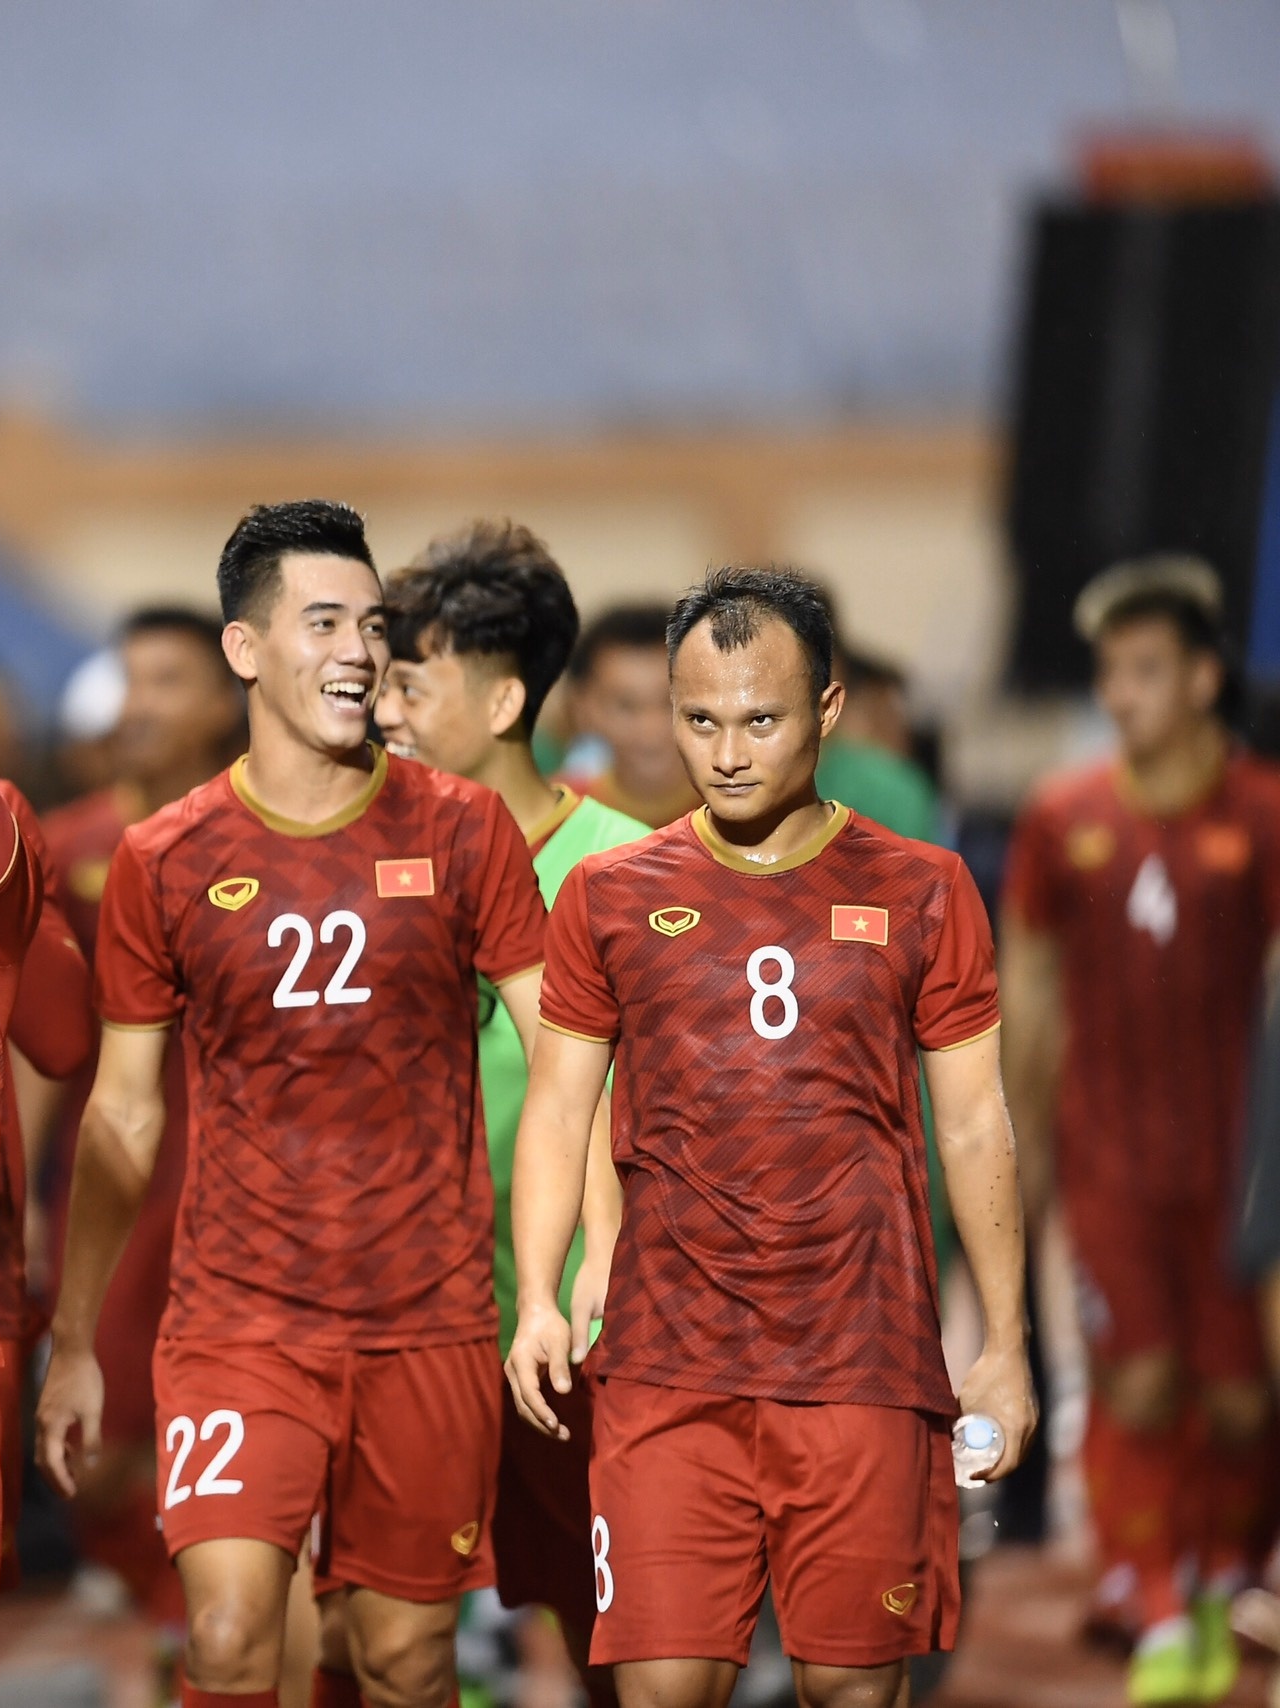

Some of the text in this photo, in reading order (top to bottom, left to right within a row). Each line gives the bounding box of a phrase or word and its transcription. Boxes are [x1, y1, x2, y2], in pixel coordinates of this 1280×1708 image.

[267, 909, 372, 1009] 22
[746, 945, 799, 1040] 8
[164, 1408, 245, 1511] 22
[591, 1514, 614, 1613] 8
